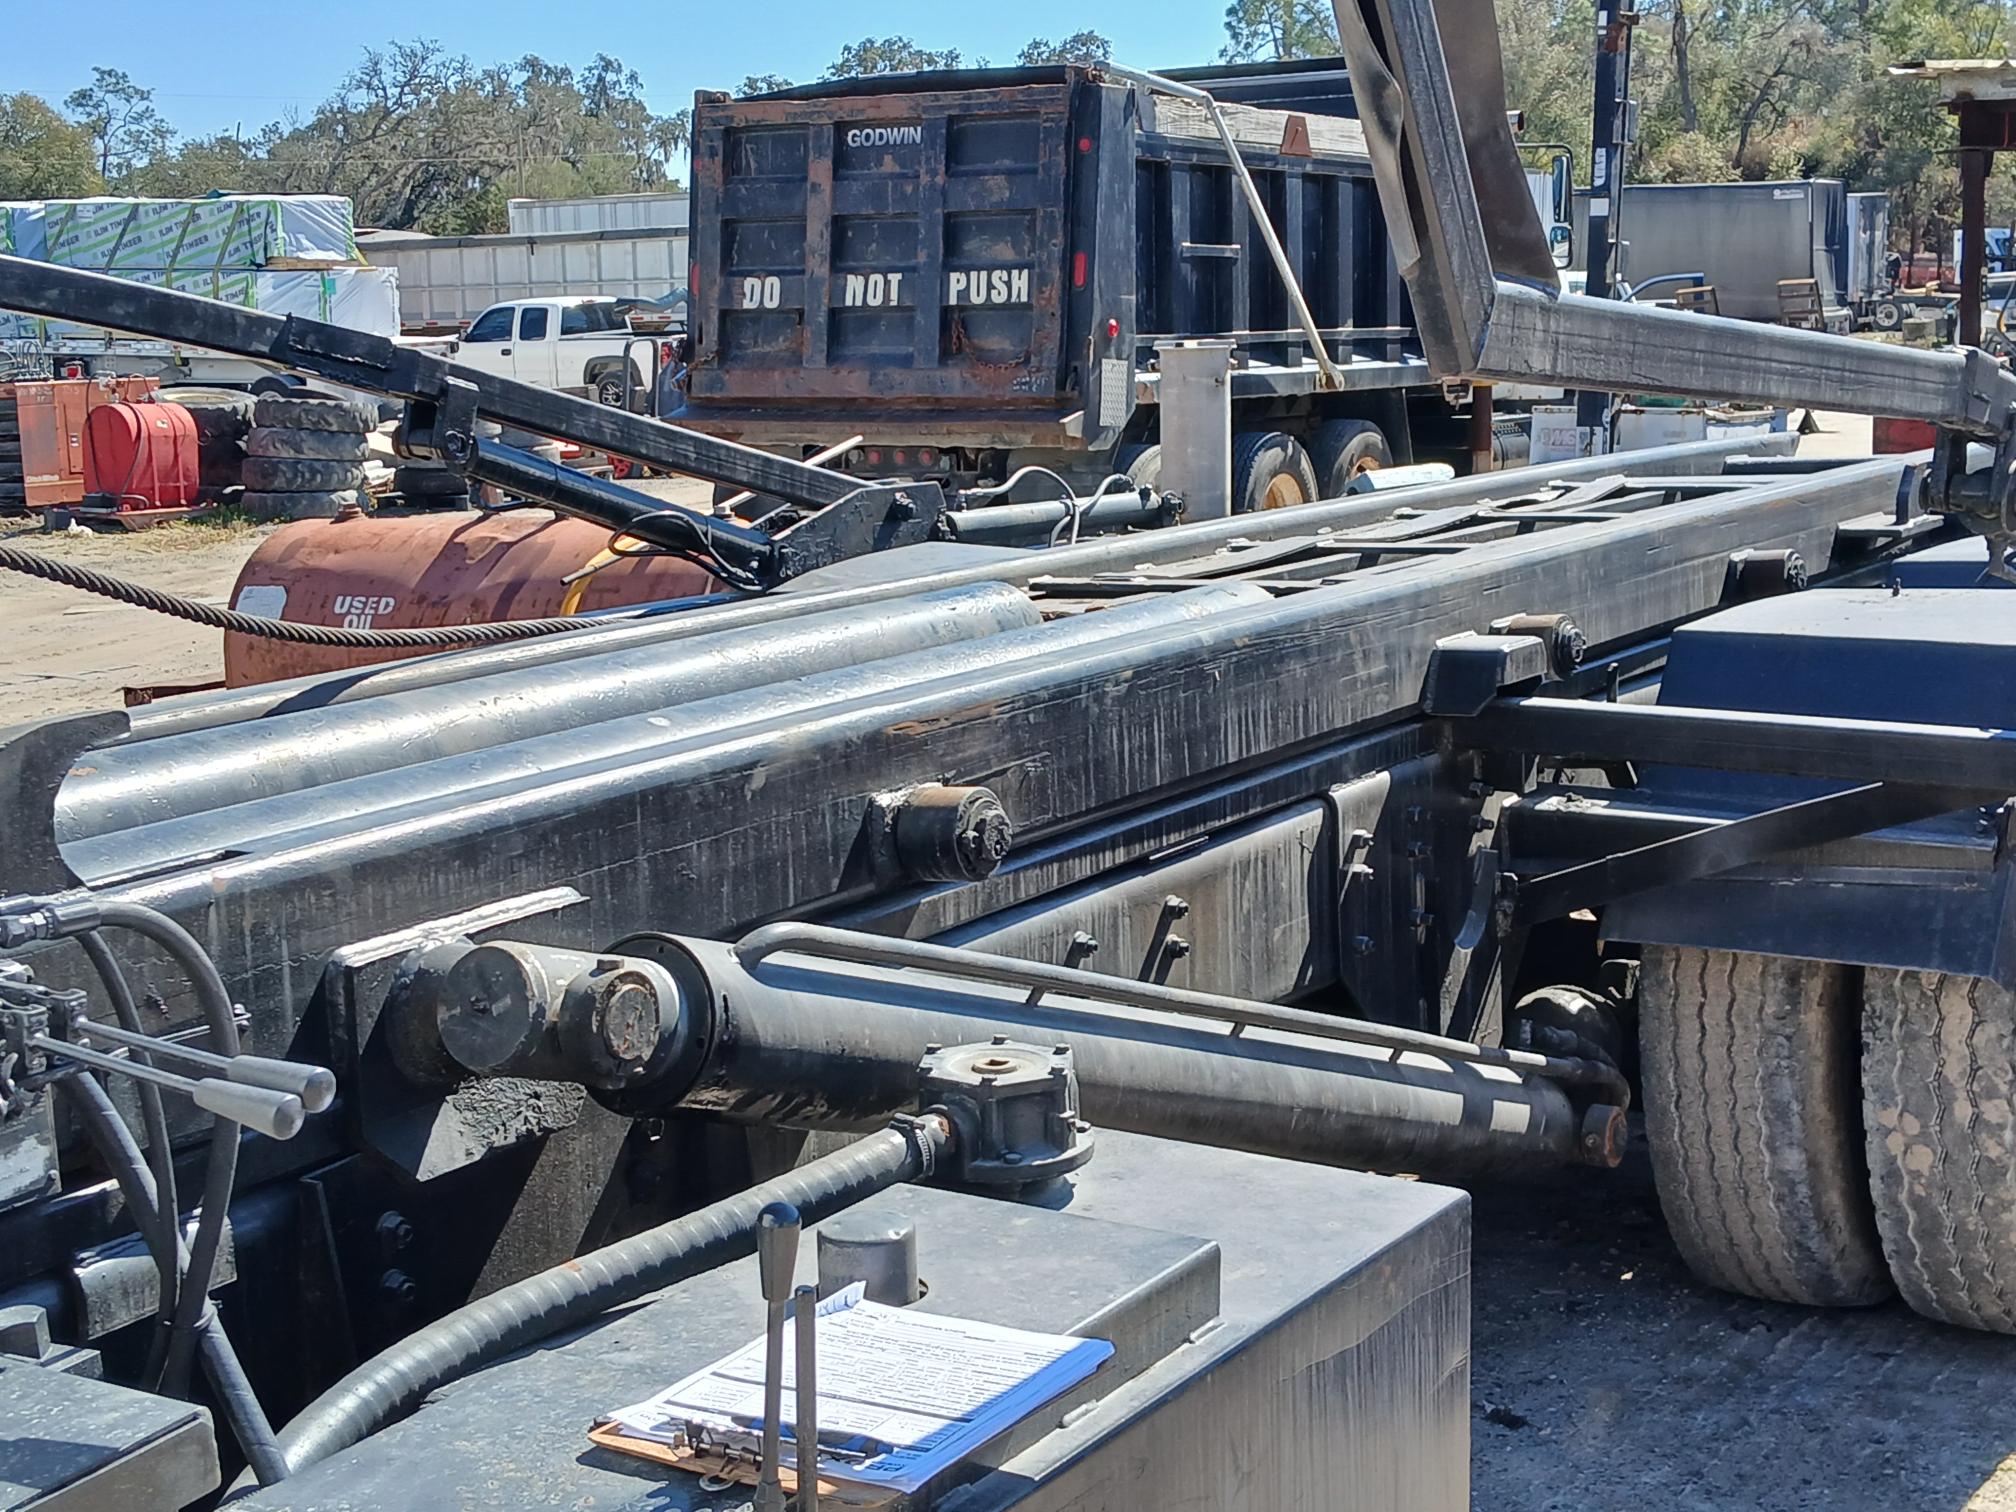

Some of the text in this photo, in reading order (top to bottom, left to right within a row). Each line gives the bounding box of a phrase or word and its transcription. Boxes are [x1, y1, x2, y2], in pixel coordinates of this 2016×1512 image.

[847, 126, 922, 147] GODWIN
[742, 269, 1029, 309] DO NOT PUSH
[333, 595, 396, 615] USED
